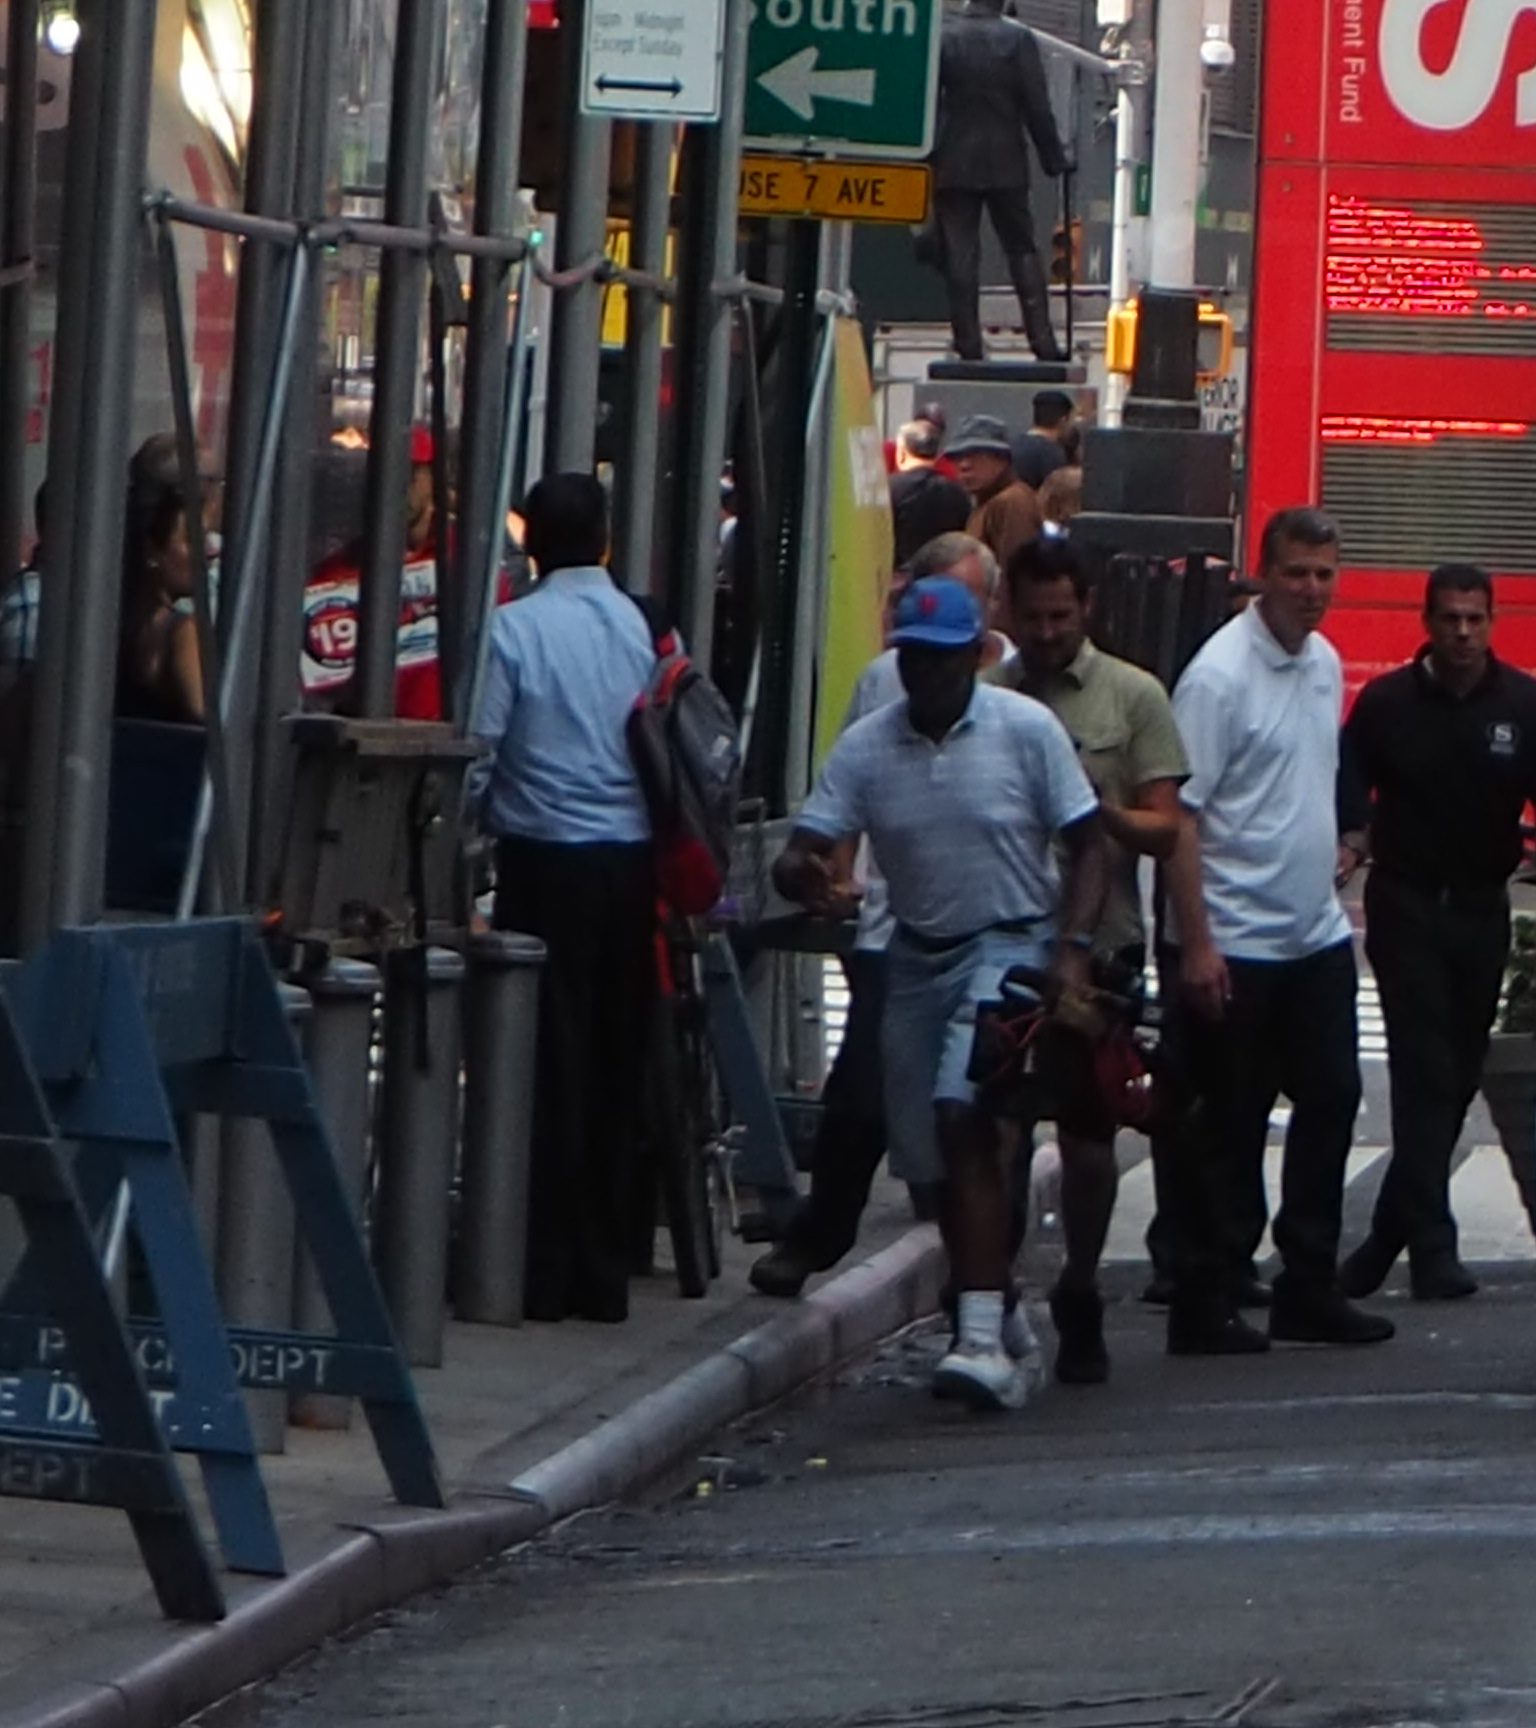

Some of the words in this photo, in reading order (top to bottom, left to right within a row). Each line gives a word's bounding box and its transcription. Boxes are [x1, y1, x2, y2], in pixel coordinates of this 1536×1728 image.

[1339, 57, 1366, 123] Fund
[802, 175, 818, 201] 7
[836, 178, 887, 206] AVE
